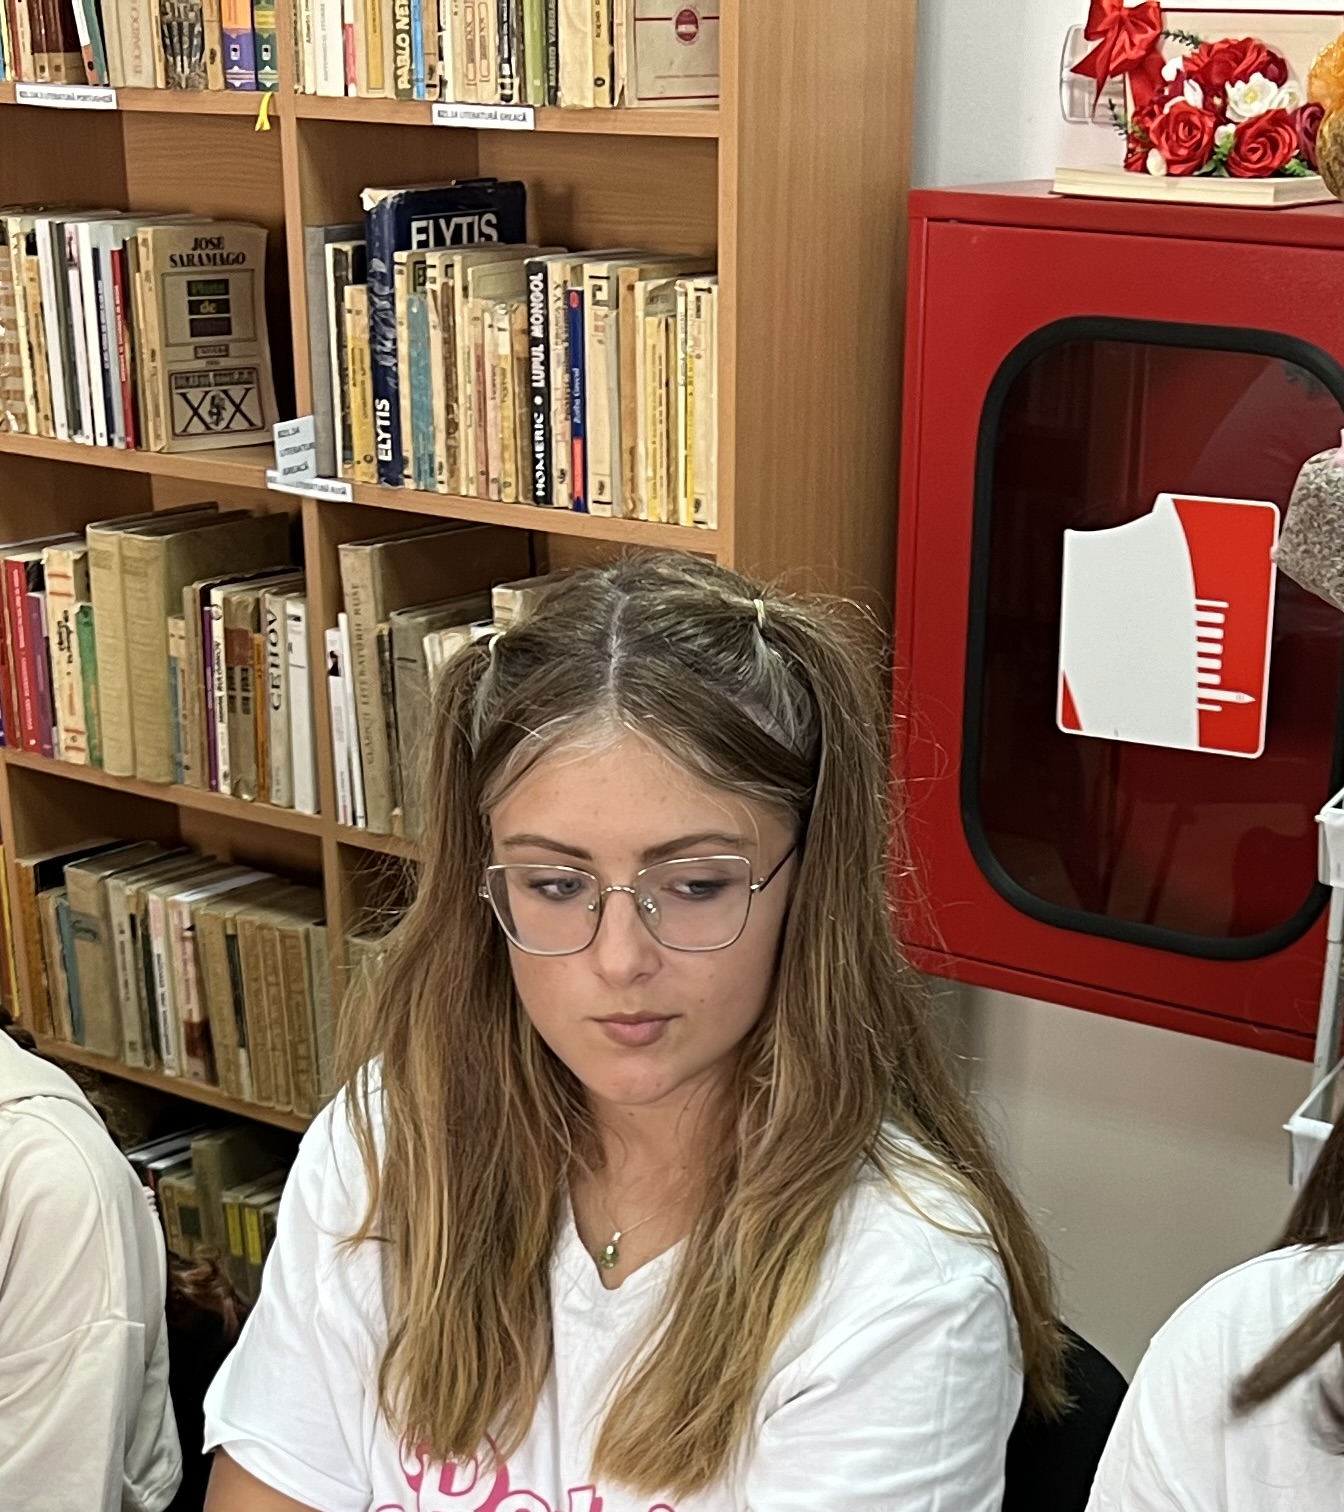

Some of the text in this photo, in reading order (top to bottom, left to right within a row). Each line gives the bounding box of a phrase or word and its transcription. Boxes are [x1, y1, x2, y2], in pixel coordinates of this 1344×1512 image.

[396, 34, 412, 89] PABLO
[169, 252, 246, 268] SARAMAGO
[529, 272, 547, 496] HOMERIC LUPUL MONGOL
[375, 398, 393, 461] ELYTIS
[266, 610, 282, 710] CEHOV
